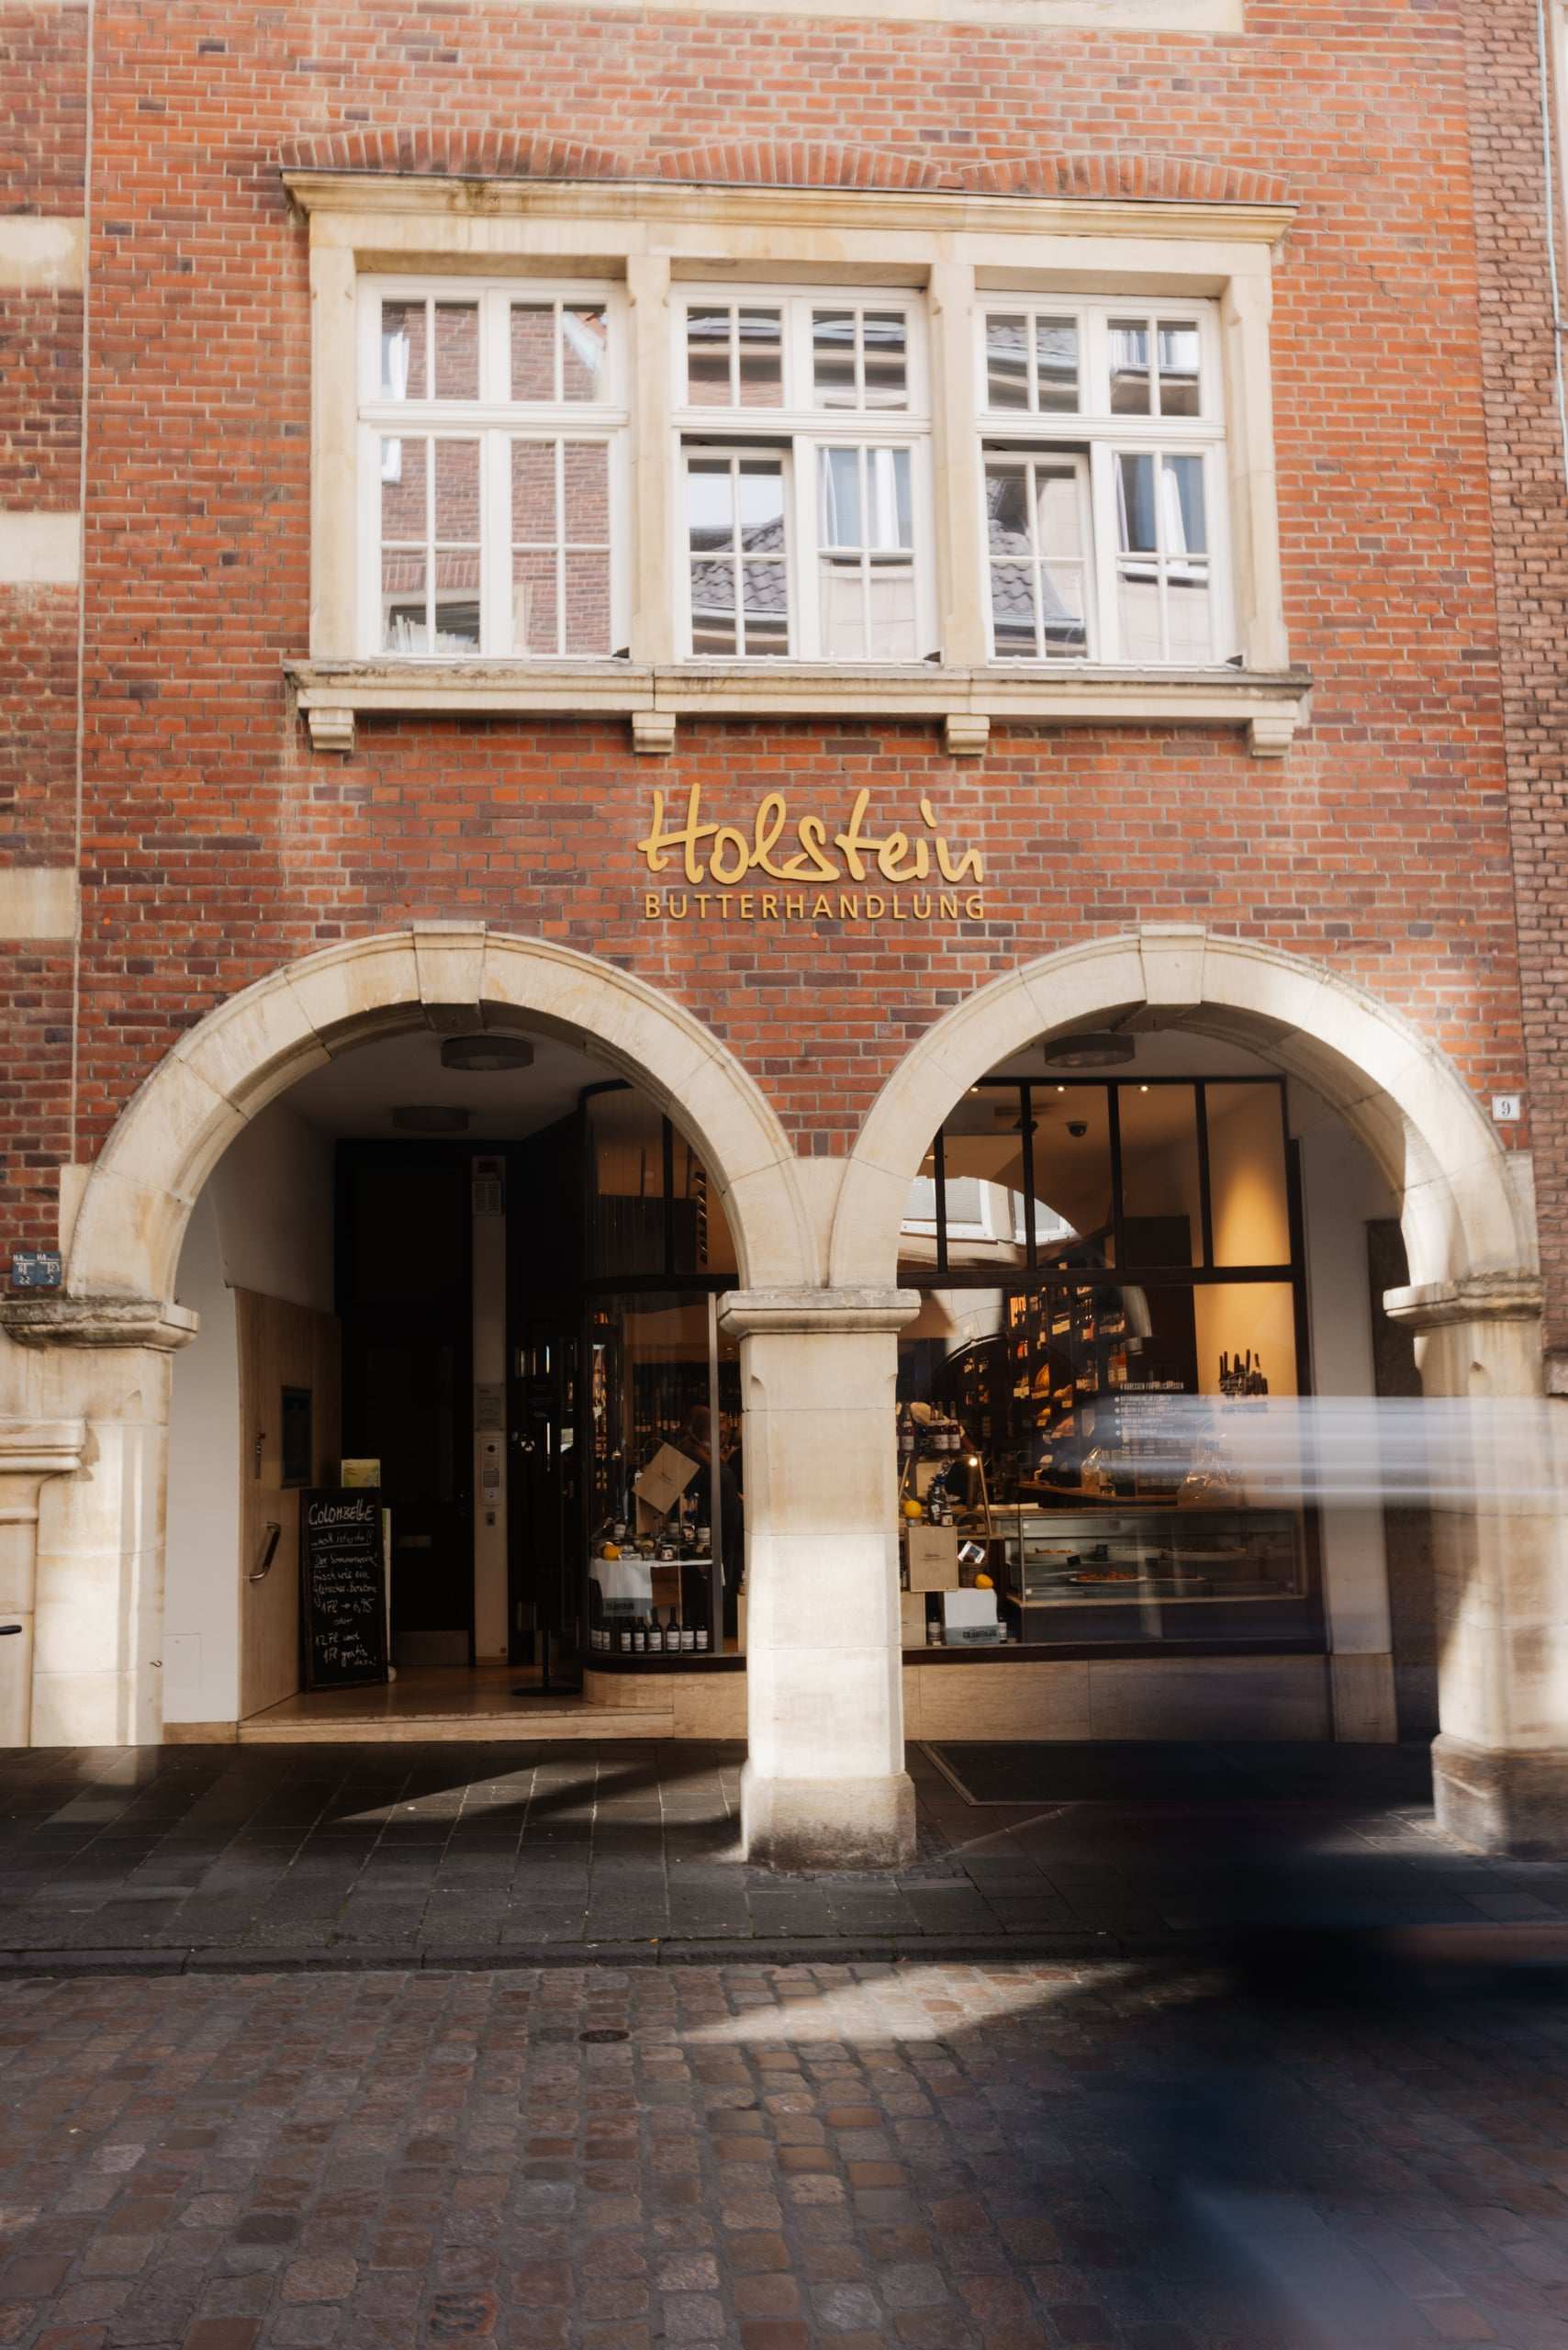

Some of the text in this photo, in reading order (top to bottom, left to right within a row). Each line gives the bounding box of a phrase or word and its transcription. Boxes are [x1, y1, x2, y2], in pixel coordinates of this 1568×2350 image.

[637, 782, 984, 884] Holstein
[644, 894, 984, 919] BUTTERHANDLUNG
[1501, 1101, 1511, 1117] 9
